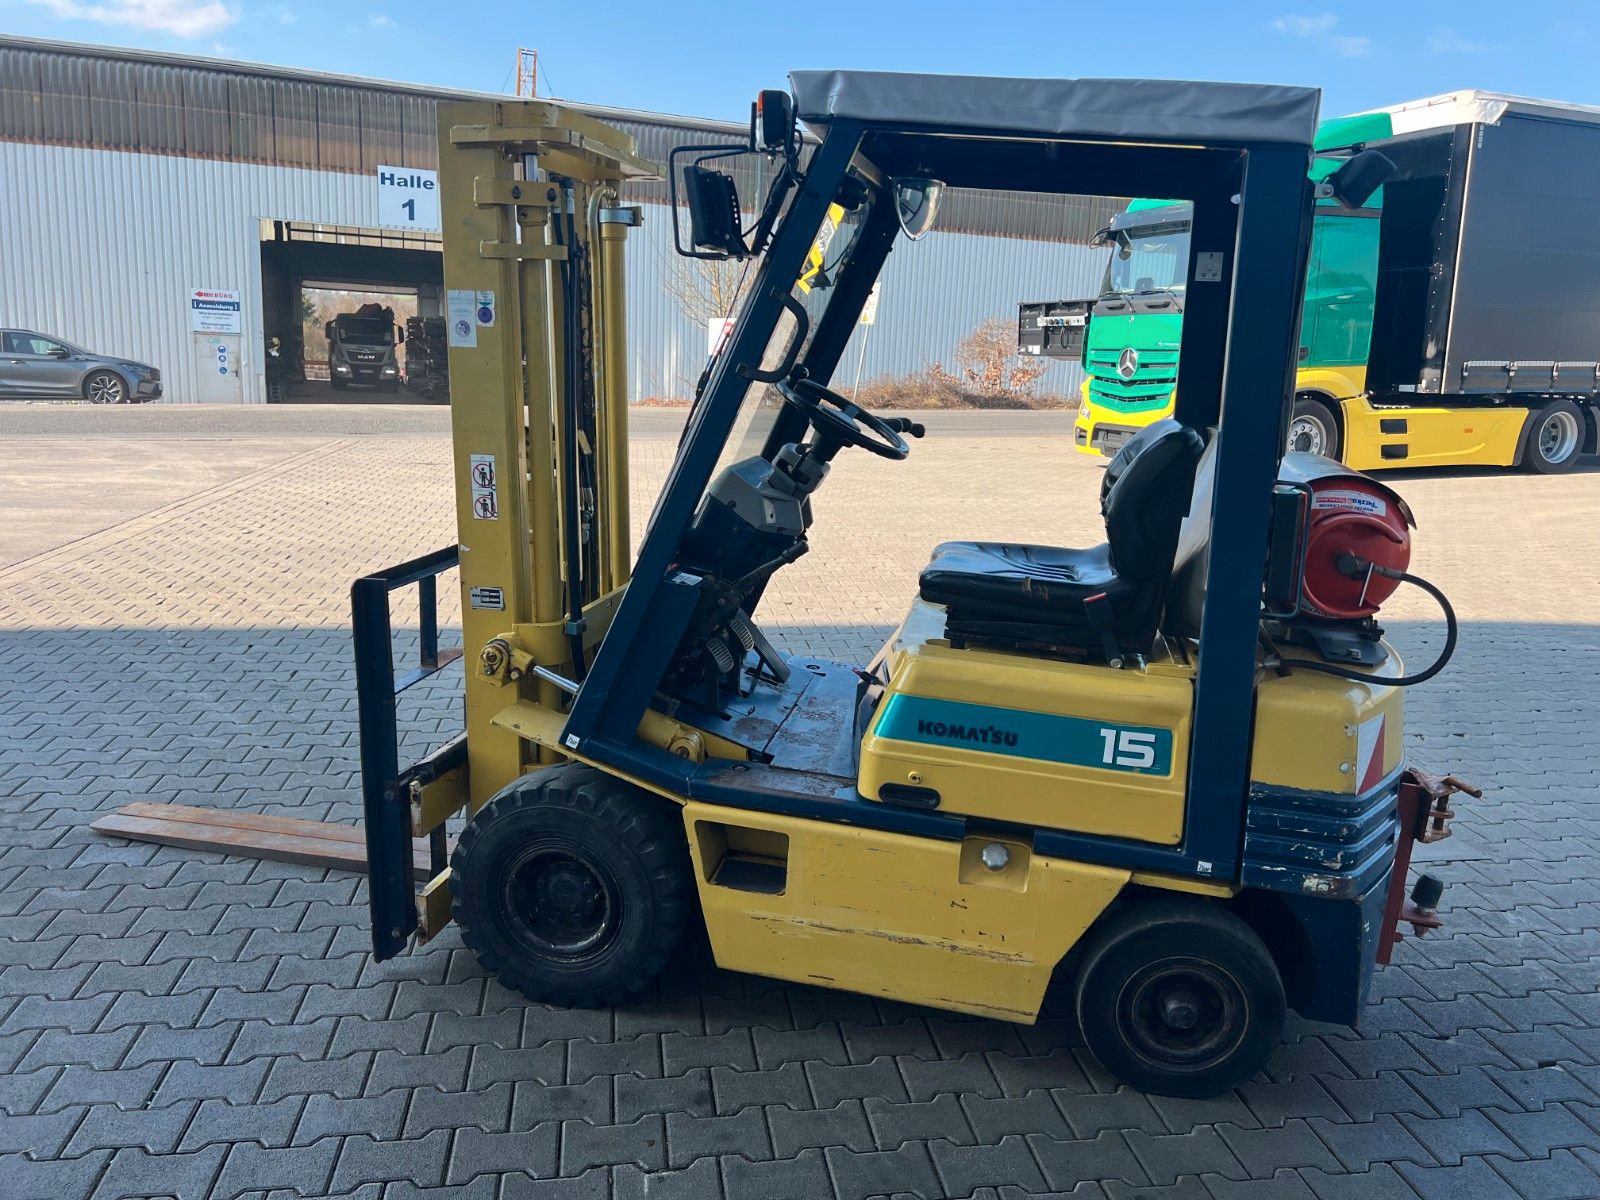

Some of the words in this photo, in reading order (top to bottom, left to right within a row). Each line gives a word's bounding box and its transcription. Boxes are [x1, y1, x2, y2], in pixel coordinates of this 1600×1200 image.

[380, 172, 435, 190] Halle
[402, 199, 415, 221] 1
[214, 291, 233, 299] BÜRO
[918, 720, 1018, 747] KOMATSU
[1100, 728, 1156, 768] 15
